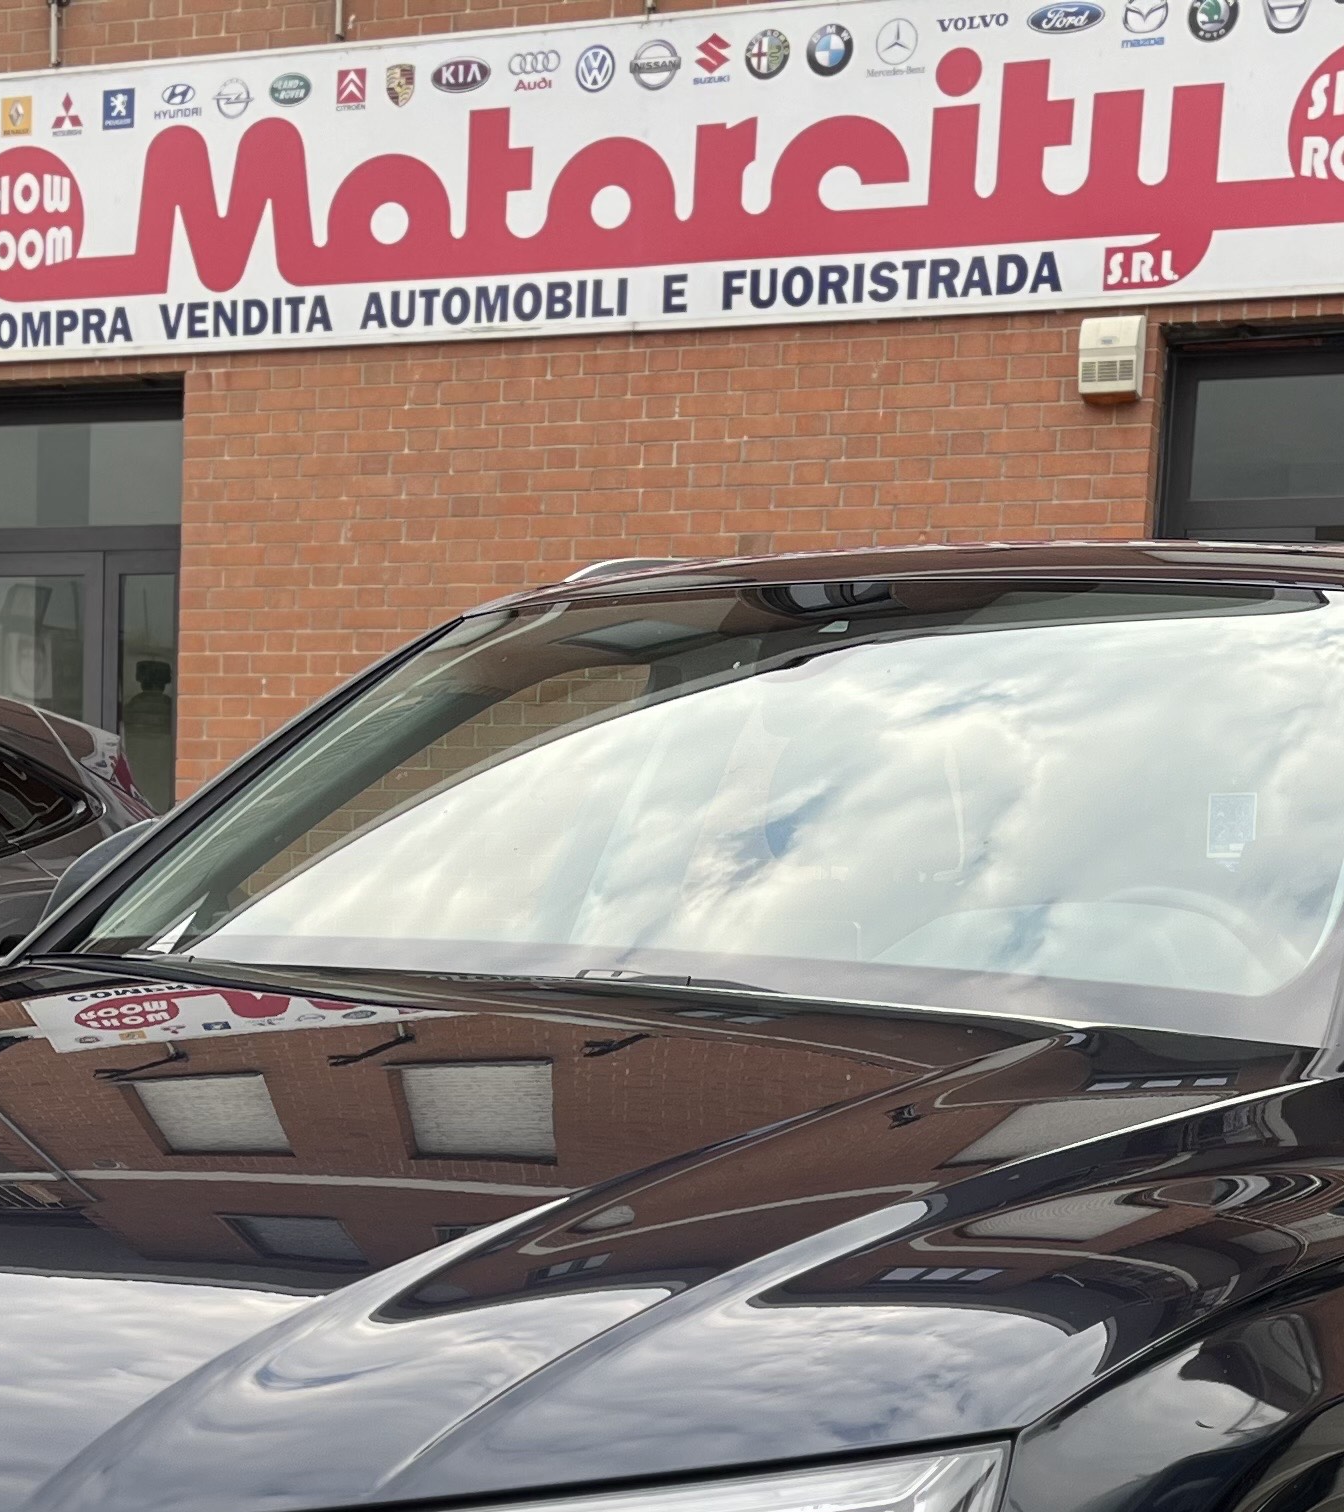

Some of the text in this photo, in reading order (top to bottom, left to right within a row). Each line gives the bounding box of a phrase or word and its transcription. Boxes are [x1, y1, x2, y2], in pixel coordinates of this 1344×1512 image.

[937, 13, 1009, 32] VOLVO
[1041, 6, 1089, 29] Ford
[634, 60, 677, 72] NISSAN
[866, 66, 926, 78] Mercedes-Benz
[441, 63, 482, 85] KIA
[693, 75, 730, 85] SUZUKI
[273, 79, 299, 90] LAND
[514, 77, 553, 92] Audi
[279, 88, 306, 100] ROVER
[154, 107, 202, 120] HYUNDAI
[135, 46, 1225, 292] Motorcity
[159, 294, 332, 340] VENDITA
[361, 277, 628, 330] AUTOMOBILI
[663, 273, 688, 314] E
[722, 251, 1062, 311] FUORISTRADA
